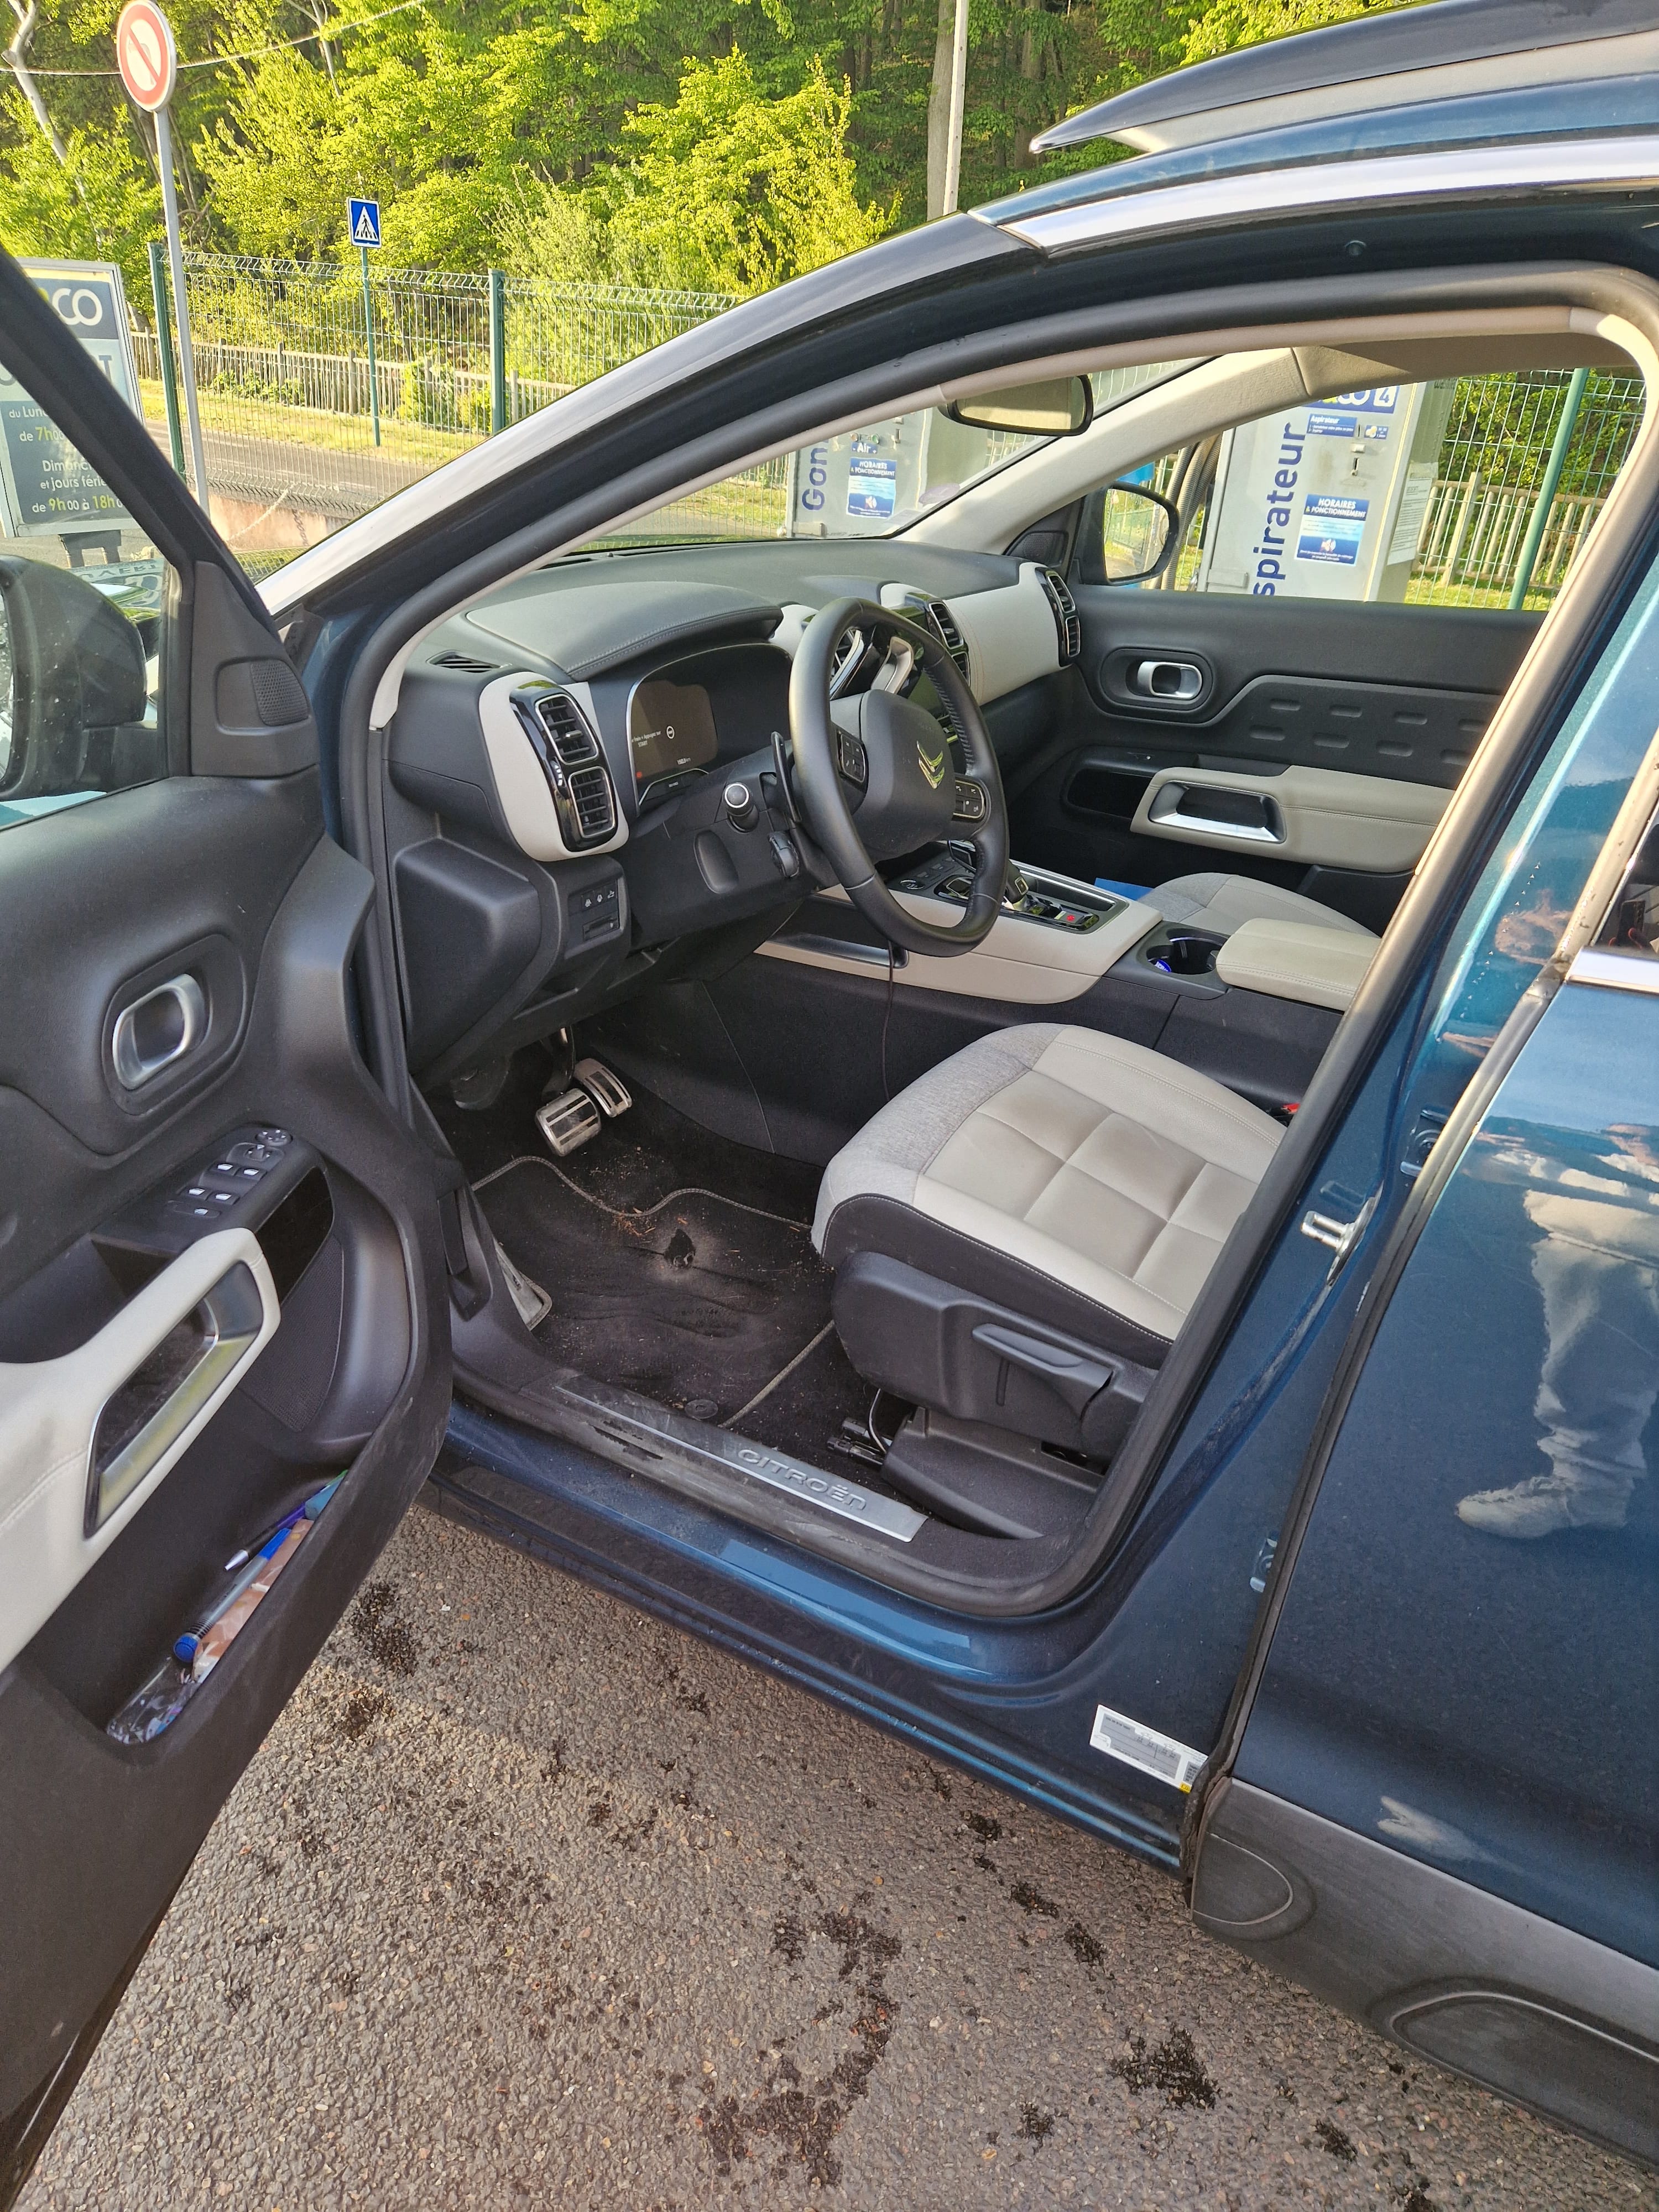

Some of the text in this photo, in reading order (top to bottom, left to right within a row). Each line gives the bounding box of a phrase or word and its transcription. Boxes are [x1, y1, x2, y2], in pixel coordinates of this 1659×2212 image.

[9, 409, 20, 418] du
[1311, 415, 1340, 424] Aspirateur
[19, 431, 33, 441] de
[857, 442, 872, 453] Air
[859, 461, 887, 470] HORAIRES
[802, 439, 829, 510] Gon
[40, 478, 49, 489] et
[51, 477, 79, 491] jours
[32, 503, 46, 513] de
[82, 499, 90, 510] à
[1253, 422, 1306, 596] spirateur
[1318, 498, 1356, 510] HORAIRES
[1311, 506, 1366, 518] FONCTIONNEMENT
